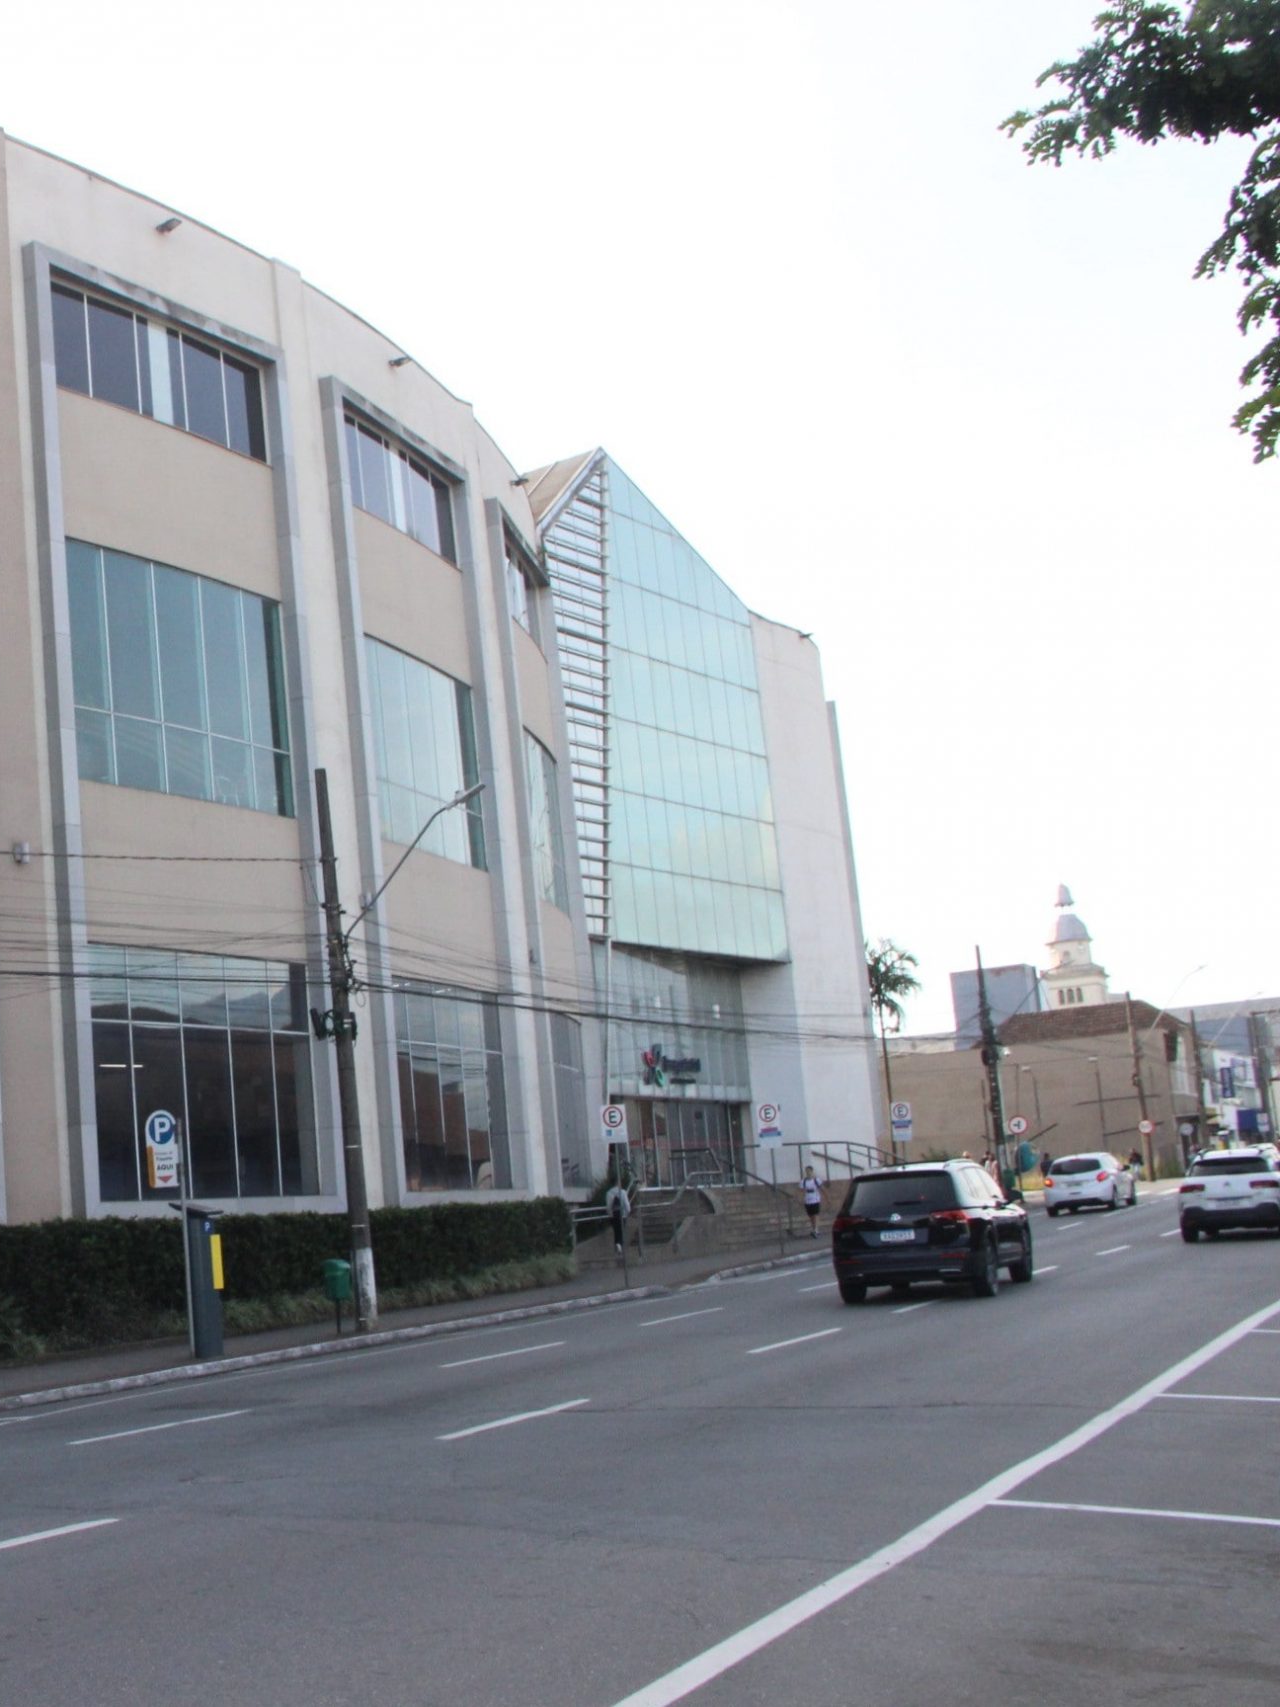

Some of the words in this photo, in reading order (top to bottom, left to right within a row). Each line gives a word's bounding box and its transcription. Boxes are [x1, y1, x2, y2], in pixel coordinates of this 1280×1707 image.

[608, 1110, 617, 1124] E
[764, 1108, 772, 1120] E
[154, 1117, 171, 1142] P
